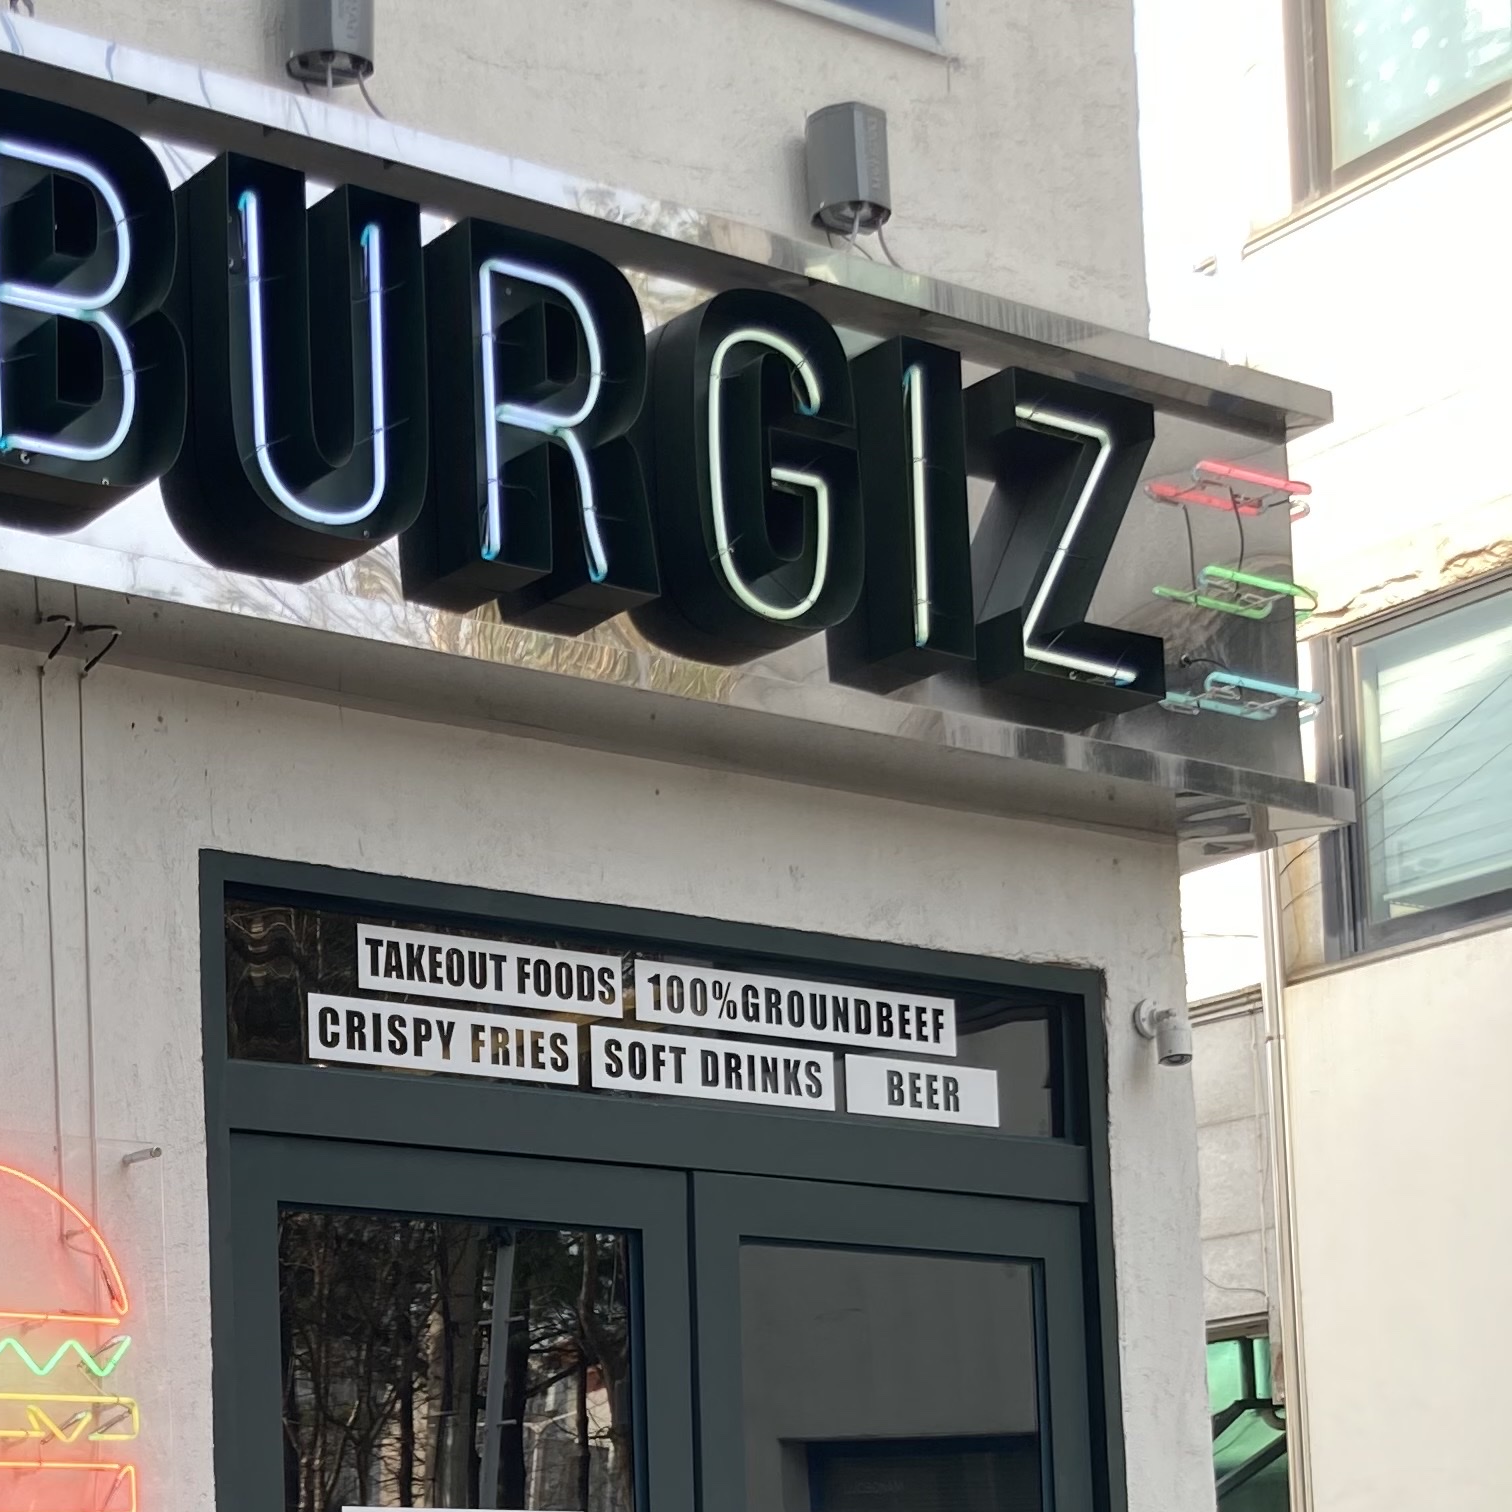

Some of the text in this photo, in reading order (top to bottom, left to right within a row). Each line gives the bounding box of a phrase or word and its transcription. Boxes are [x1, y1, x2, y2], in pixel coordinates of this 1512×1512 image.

[364, 936, 616, 1006] TAKEOUT FOODS
[317, 1005, 570, 1073] CRISPY FRIES
[646, 972, 945, 1045] 100%GROUNDBEEF
[603, 1038, 823, 1099] SOFT DRINKS
[886, 1069, 961, 1113] BEER
